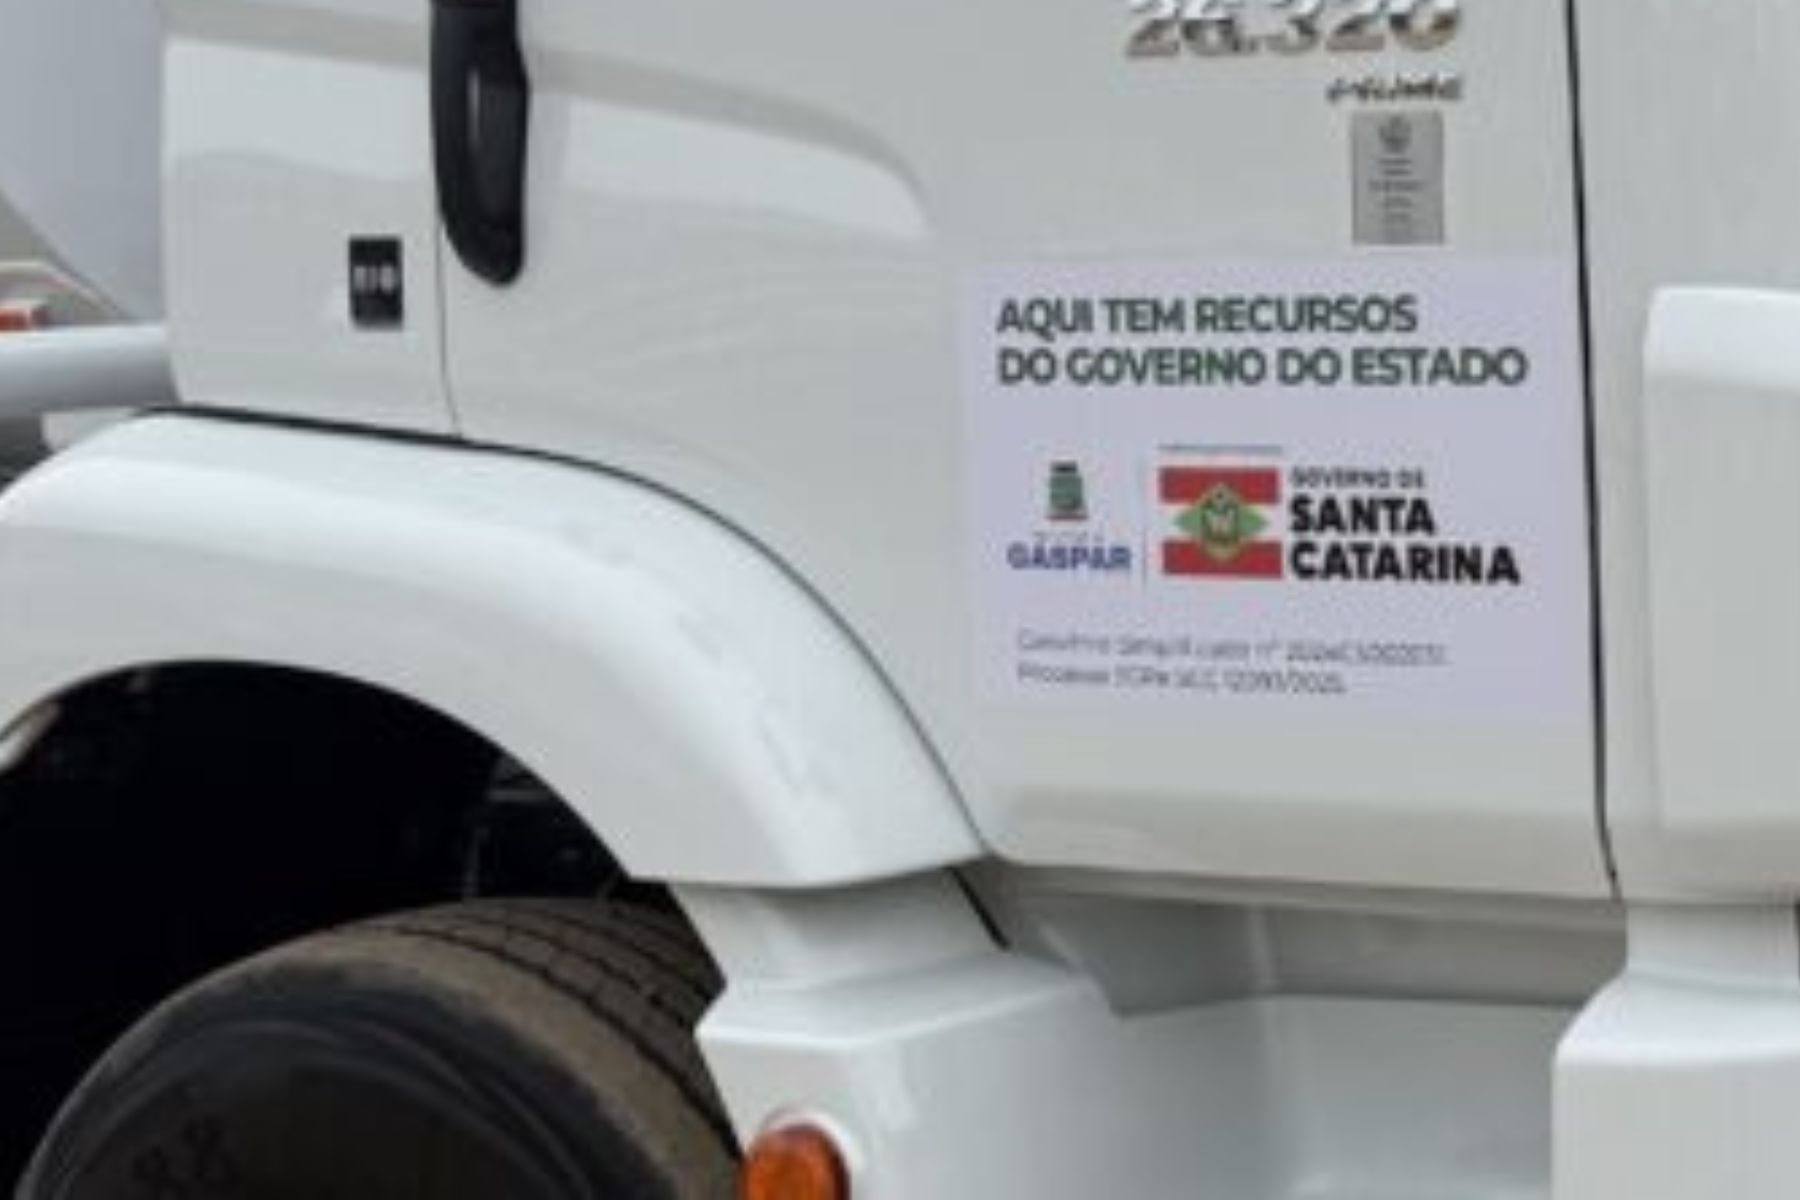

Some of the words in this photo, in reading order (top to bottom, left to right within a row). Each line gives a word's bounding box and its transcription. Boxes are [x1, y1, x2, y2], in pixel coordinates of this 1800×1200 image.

[997, 297, 1093, 341] AQUI
[1103, 298, 1185, 333] TEM
[1195, 294, 1418, 333] RECURSOS
[999, 348, 1057, 385] DO
[1065, 347, 1267, 385] GOVERNO
[1277, 347, 1342, 386] DO
[1352, 347, 1529, 386] ESTADO
[1290, 468, 1391, 489] GOVERNO
[1397, 467, 1425, 489] DE
[1289, 495, 1435, 537] SANTA
[1007, 543, 1132, 571] GASPAR
[1289, 542, 1521, 585] CATARINA
